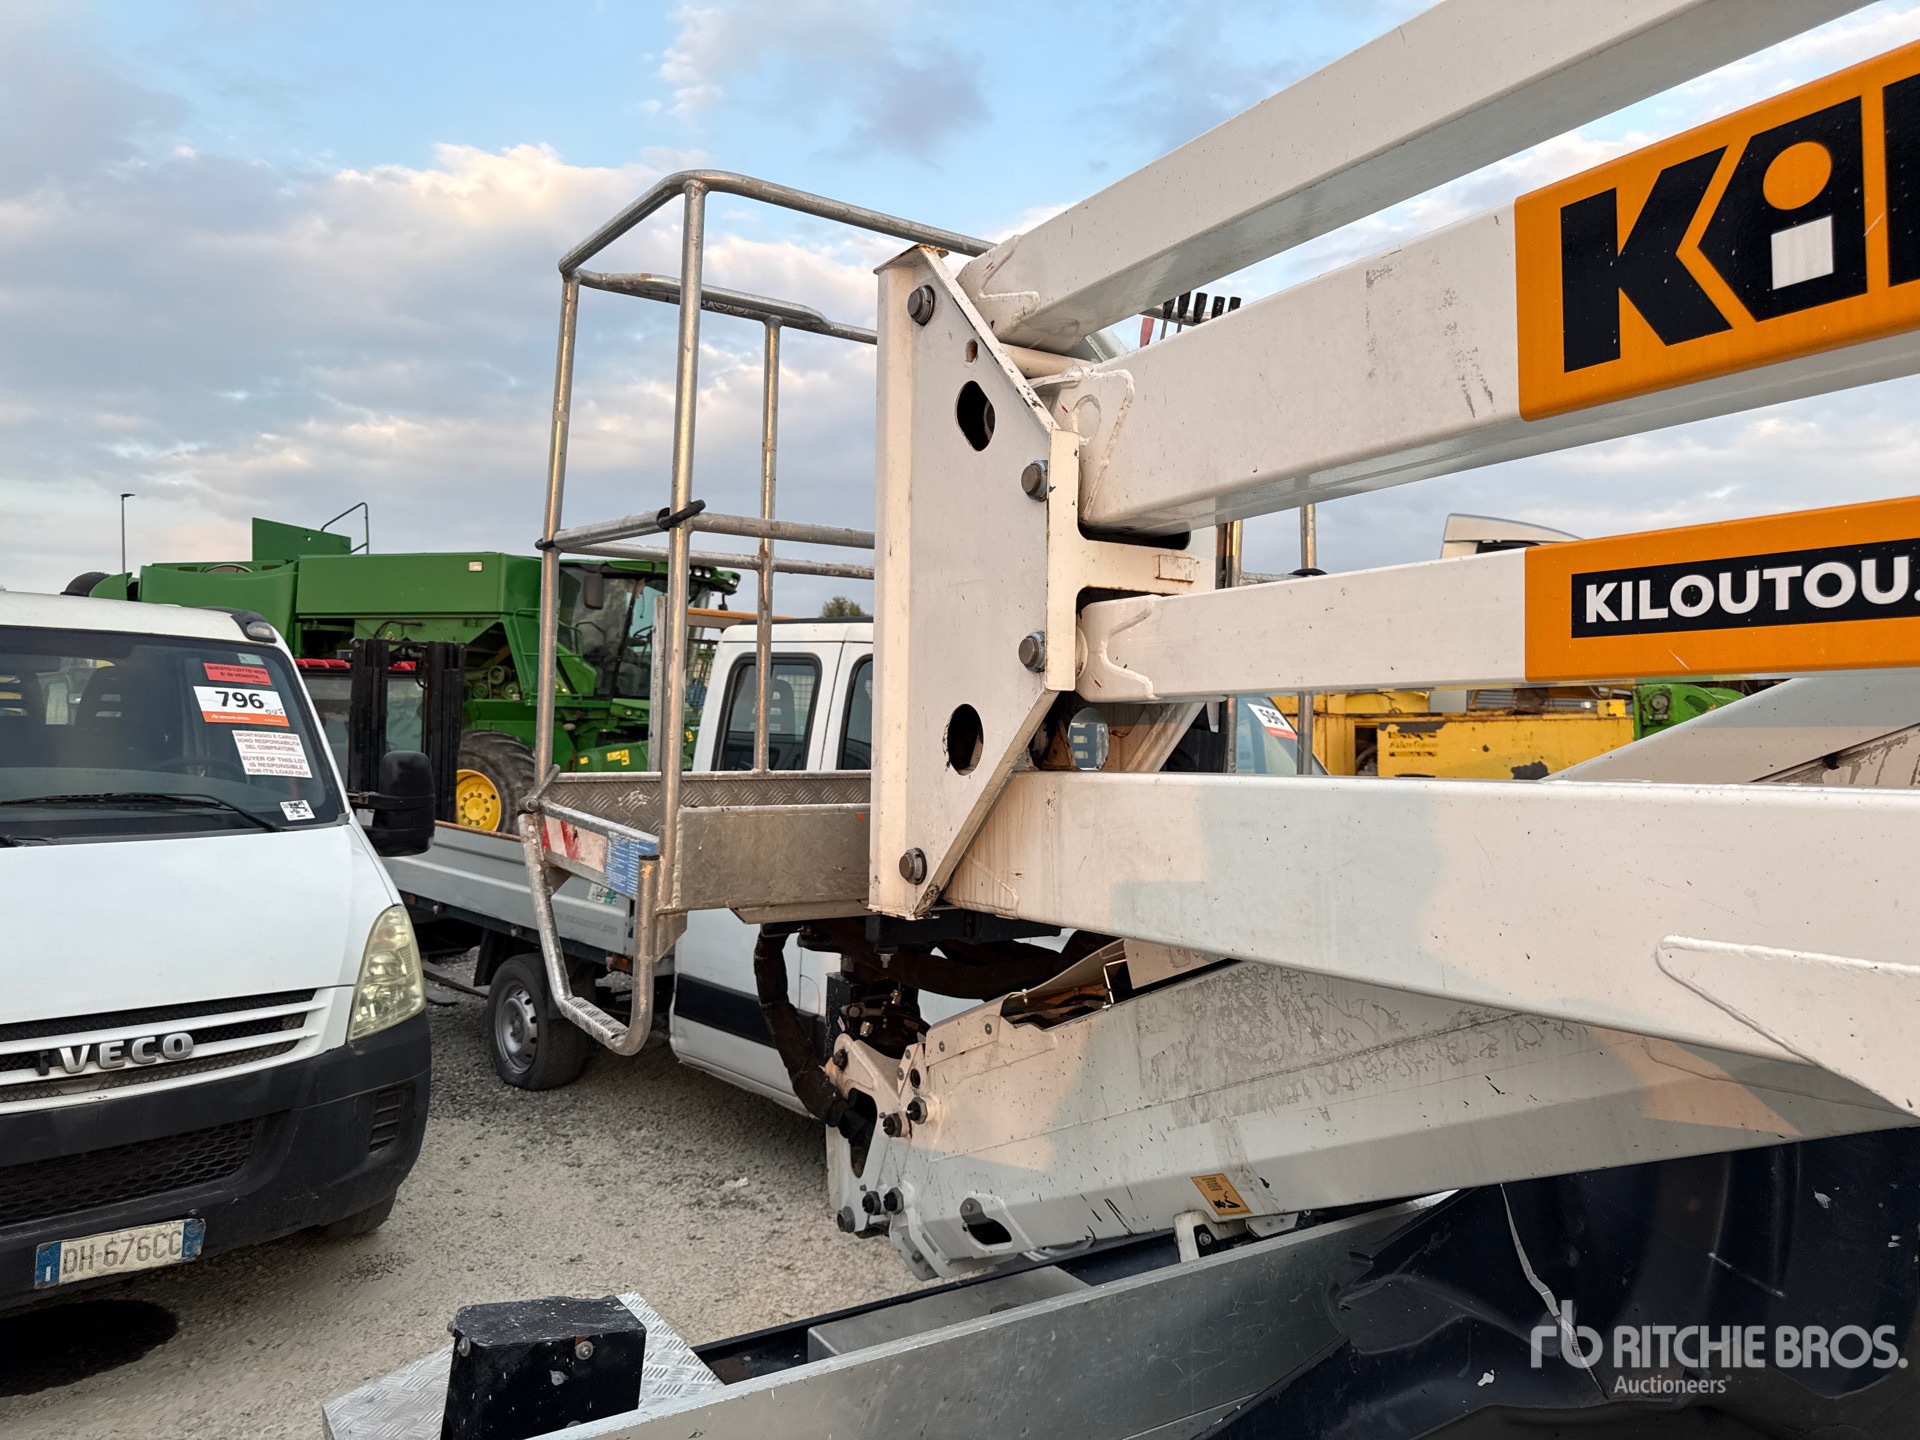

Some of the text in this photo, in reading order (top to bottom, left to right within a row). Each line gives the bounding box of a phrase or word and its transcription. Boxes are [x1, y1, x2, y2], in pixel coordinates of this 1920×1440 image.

[215, 690, 264, 709] 796
[257, 762, 304, 770] RESPONSIBLE
[37, 1032, 194, 1076] IVECO
